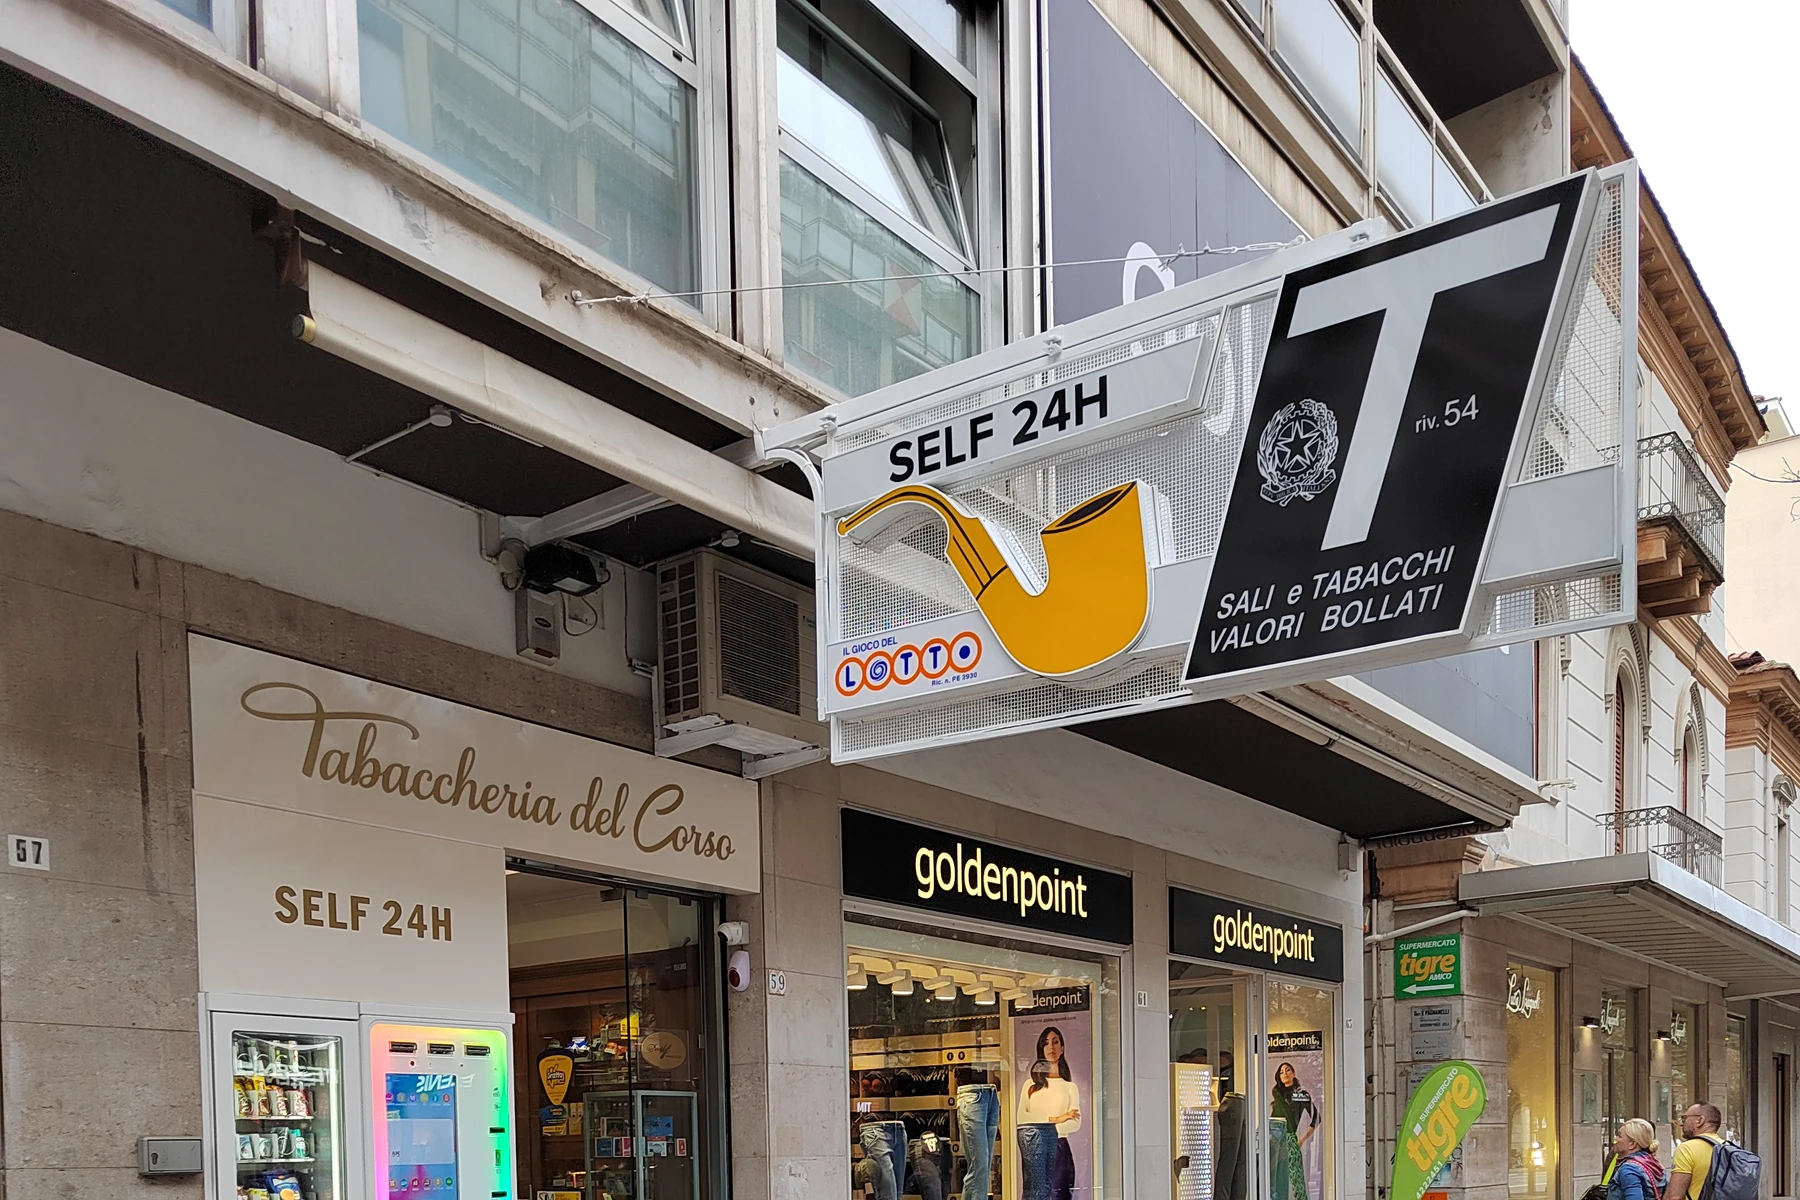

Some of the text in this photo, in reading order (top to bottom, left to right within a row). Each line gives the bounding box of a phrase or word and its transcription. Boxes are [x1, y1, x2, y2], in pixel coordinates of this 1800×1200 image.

[1287, 203, 1561, 551] T
[890, 375, 1108, 483] SELF 24H
[1415, 394, 1479, 433] riv. 54
[1216, 545, 1456, 620] SALI e TABACCHI
[842, 635, 898, 656] IL GIOCO DEL
[1210, 583, 1445, 654] VALORI BOLLATI
[837, 633, 982, 695] LOTTO
[951, 674, 961, 682] PE
[962, 671, 978, 681] 2930
[241, 681, 736, 861] Tabaccheria del Corso
[16, 838, 42, 865] 57
[915, 842, 1088, 919] goldenpoint
[274, 885, 453, 942] SELF 24H
[1213, 908, 1315, 964] goldenpoint
[1398, 938, 1457, 951] SUPERMERCATO
[1400, 952, 1456, 982] tigre
[771, 974, 785, 991] 59
[1138, 992, 1147, 1006] 61
[1428, 972, 1453, 982] AMICO
[1419, 1067, 1459, 1122] SUPERMERCATO
[1406, 1074, 1478, 1172] tigre
[1416, 1161, 1444, 1199] 4222451
